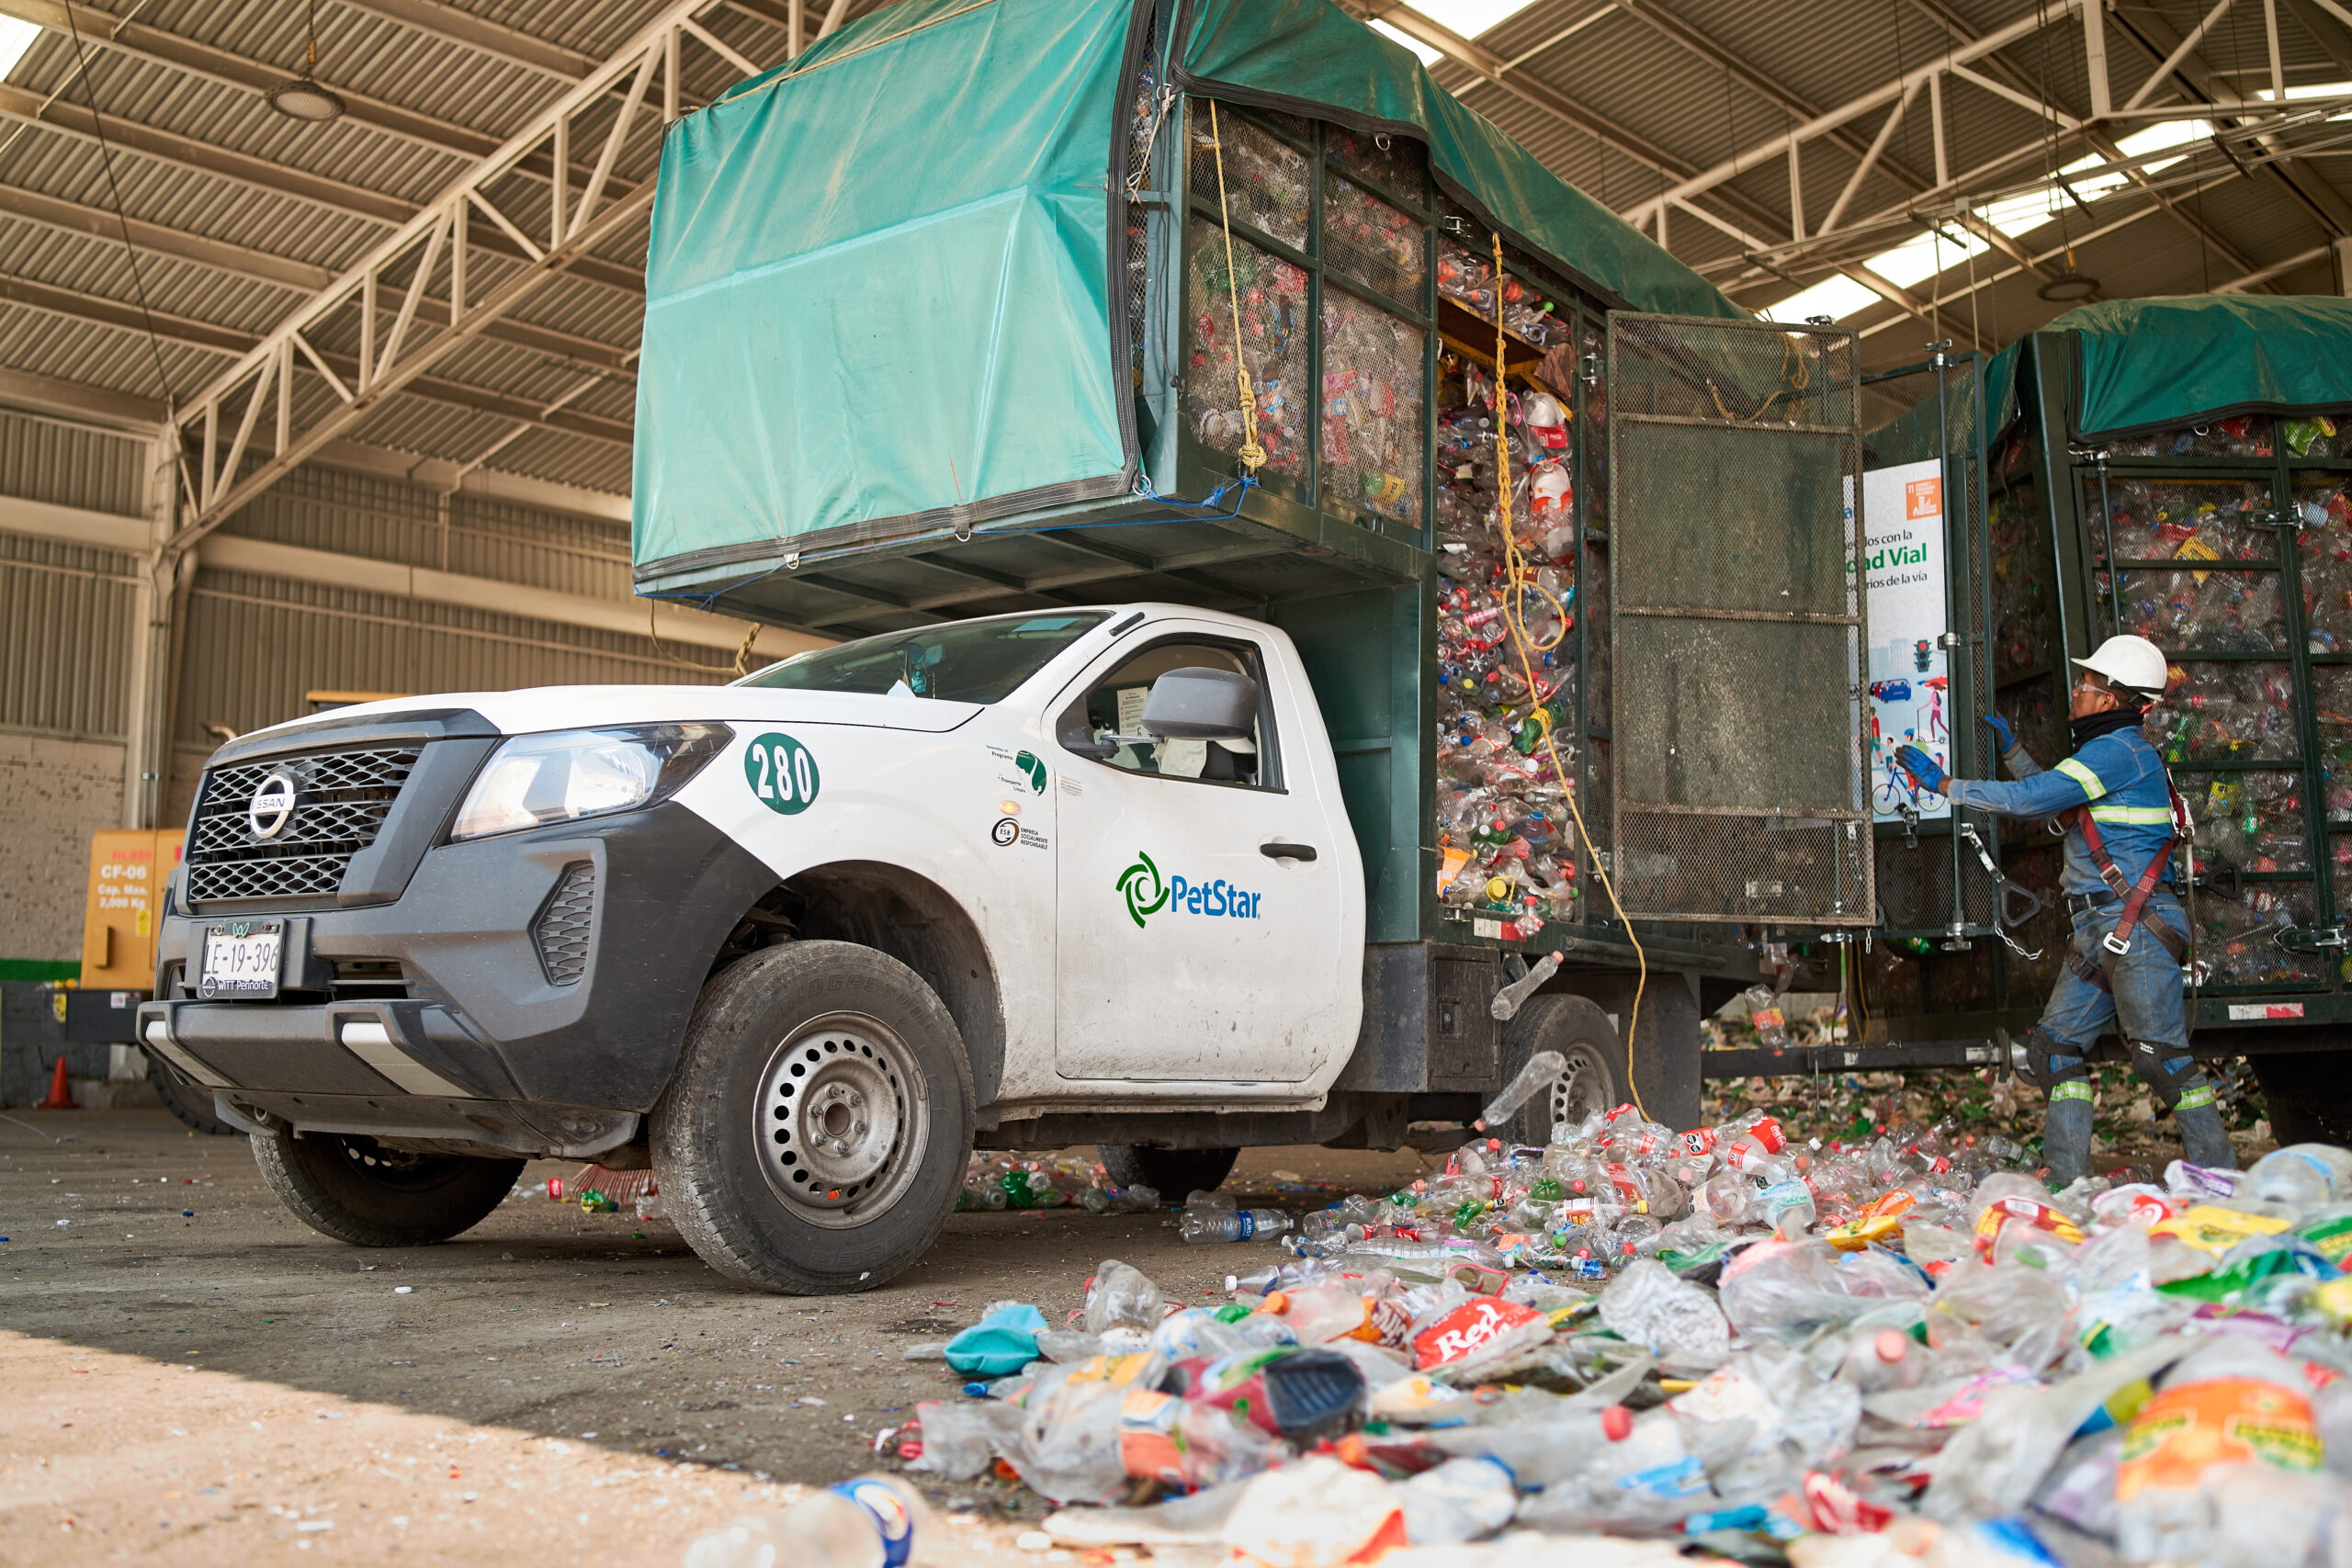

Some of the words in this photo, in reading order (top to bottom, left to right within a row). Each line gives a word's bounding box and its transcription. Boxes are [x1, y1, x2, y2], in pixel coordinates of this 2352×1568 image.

[1881, 533, 1901, 544] con
[1903, 529, 1912, 540] la
[1888, 542, 1927, 567] Vial
[1886, 575, 1900, 586] de
[1901, 573, 1910, 584] la
[992, 750, 1013, 761] Programa
[752, 743, 812, 804] 280
[1020, 827, 1039, 836] EMPRESA
[1020, 833, 1048, 844] SOCIALMENTE
[1020, 840, 1048, 851] RESPONSABLE
[1171, 875, 1261, 919] PetStar
[1435, 1303, 1502, 1363] Red
